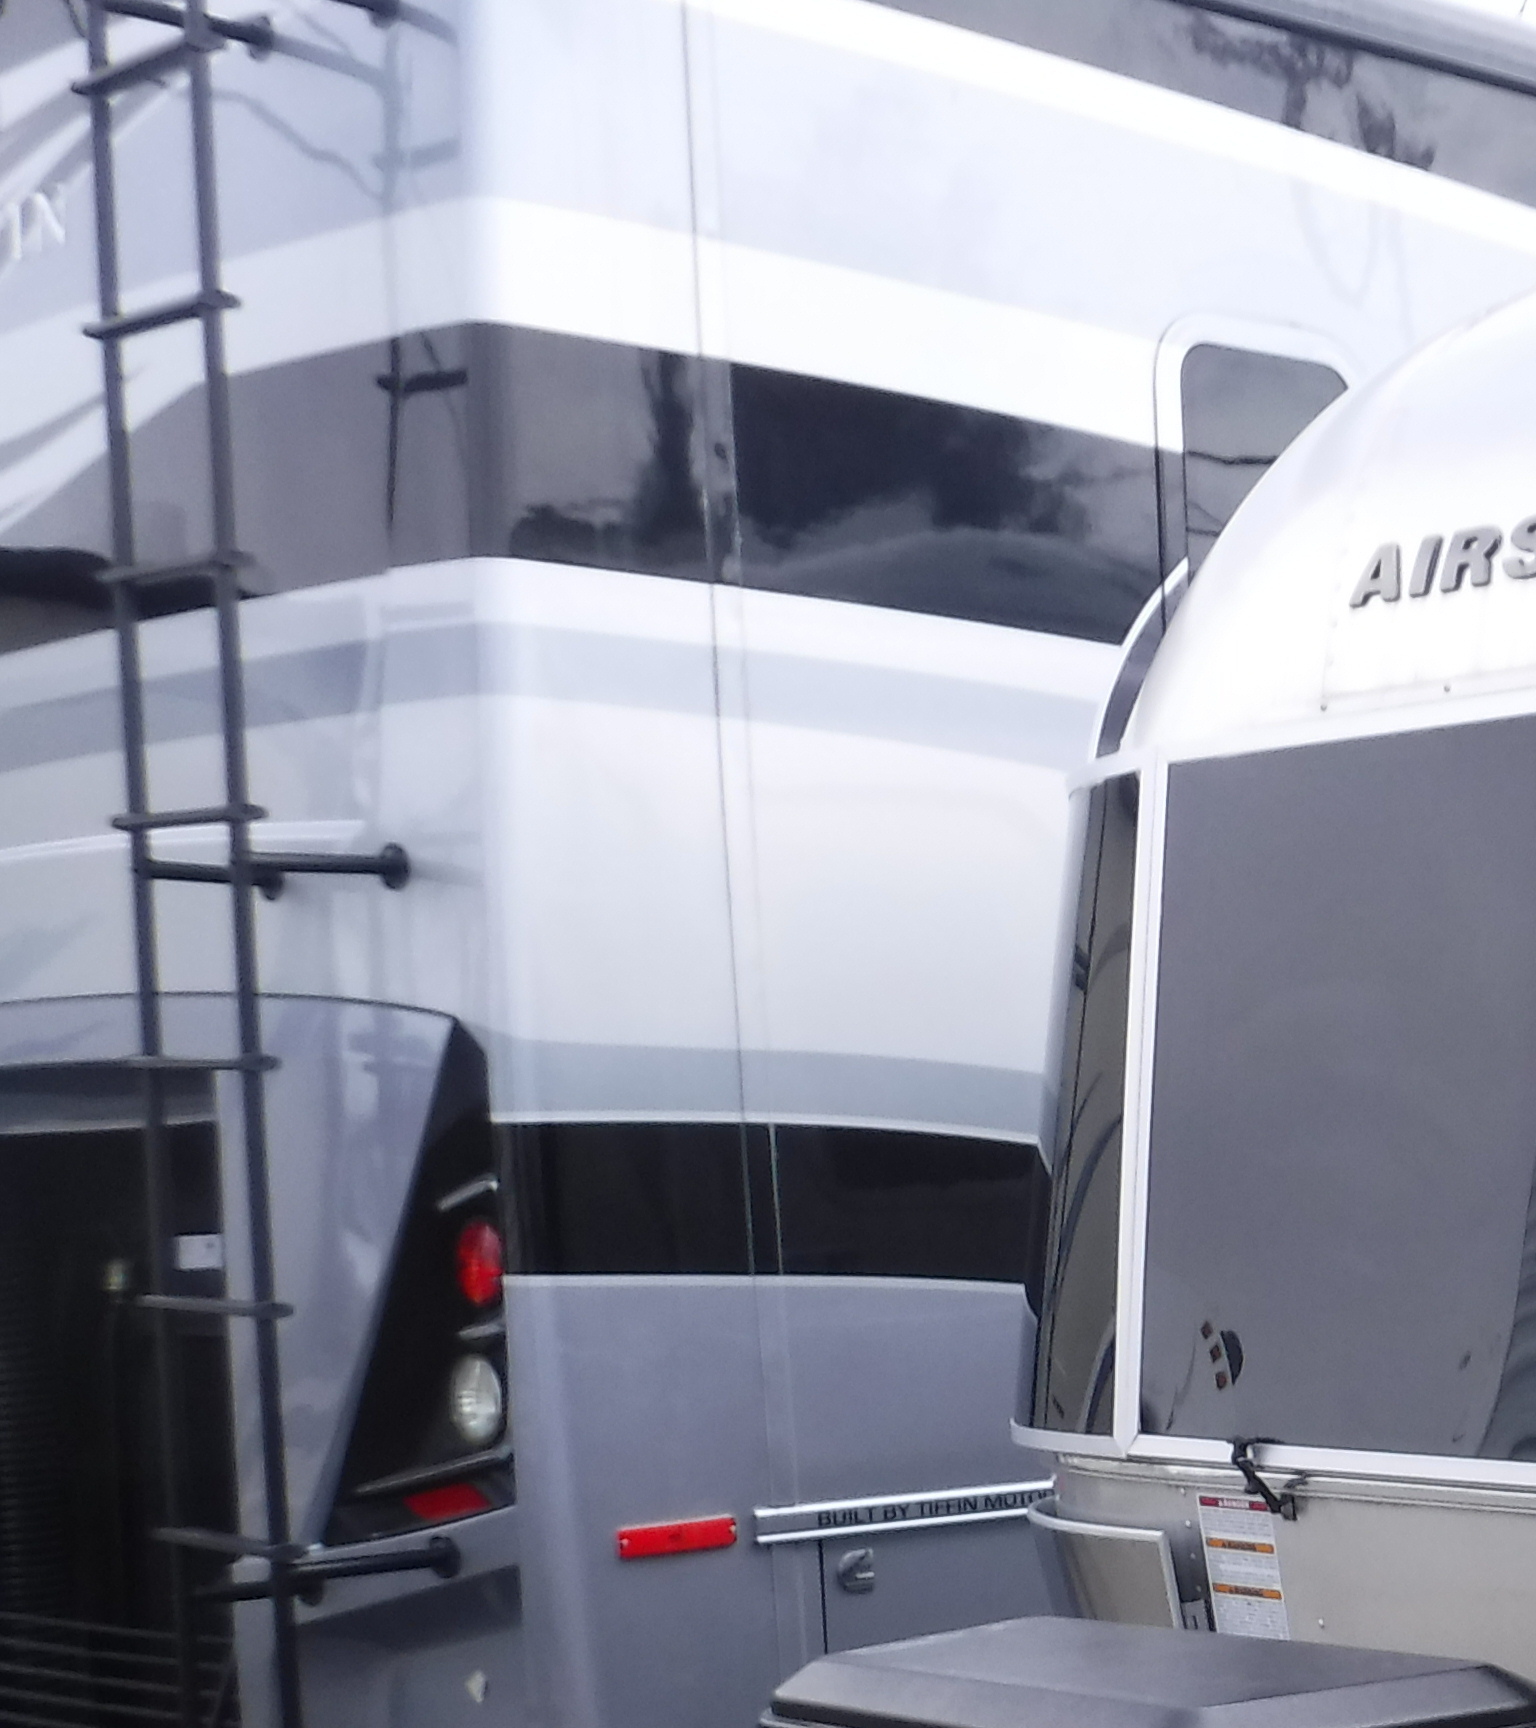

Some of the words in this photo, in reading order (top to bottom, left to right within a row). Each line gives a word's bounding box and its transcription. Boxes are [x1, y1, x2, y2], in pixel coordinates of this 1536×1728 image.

[817, 1507, 875, 1527] BUILT
[882, 1503, 911, 1521] BY
[919, 1497, 978, 1517] TIFFIN
